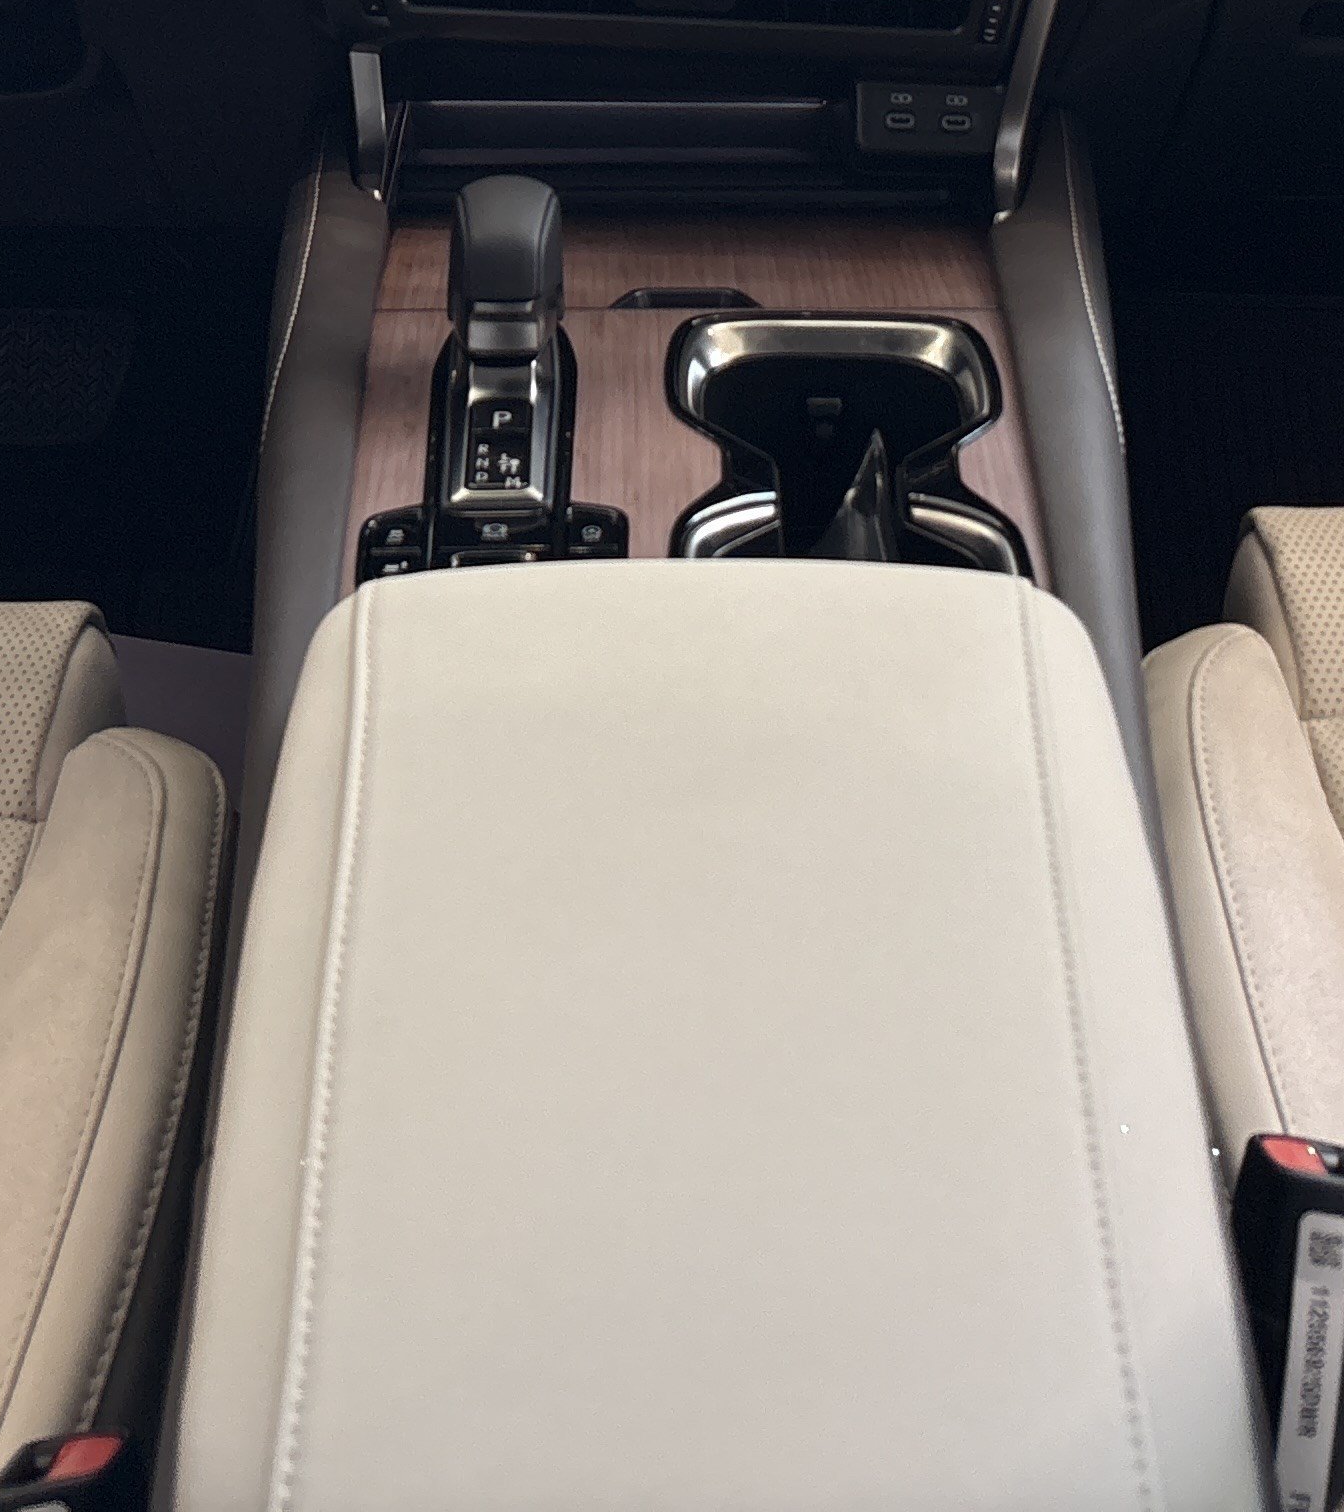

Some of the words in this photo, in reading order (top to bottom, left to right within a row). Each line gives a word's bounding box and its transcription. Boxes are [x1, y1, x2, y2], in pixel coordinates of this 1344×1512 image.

[492, 410, 513, 430] P
[478, 443, 490, 455] R
[476, 457, 490, 469] N
[475, 471, 489, 482] D
